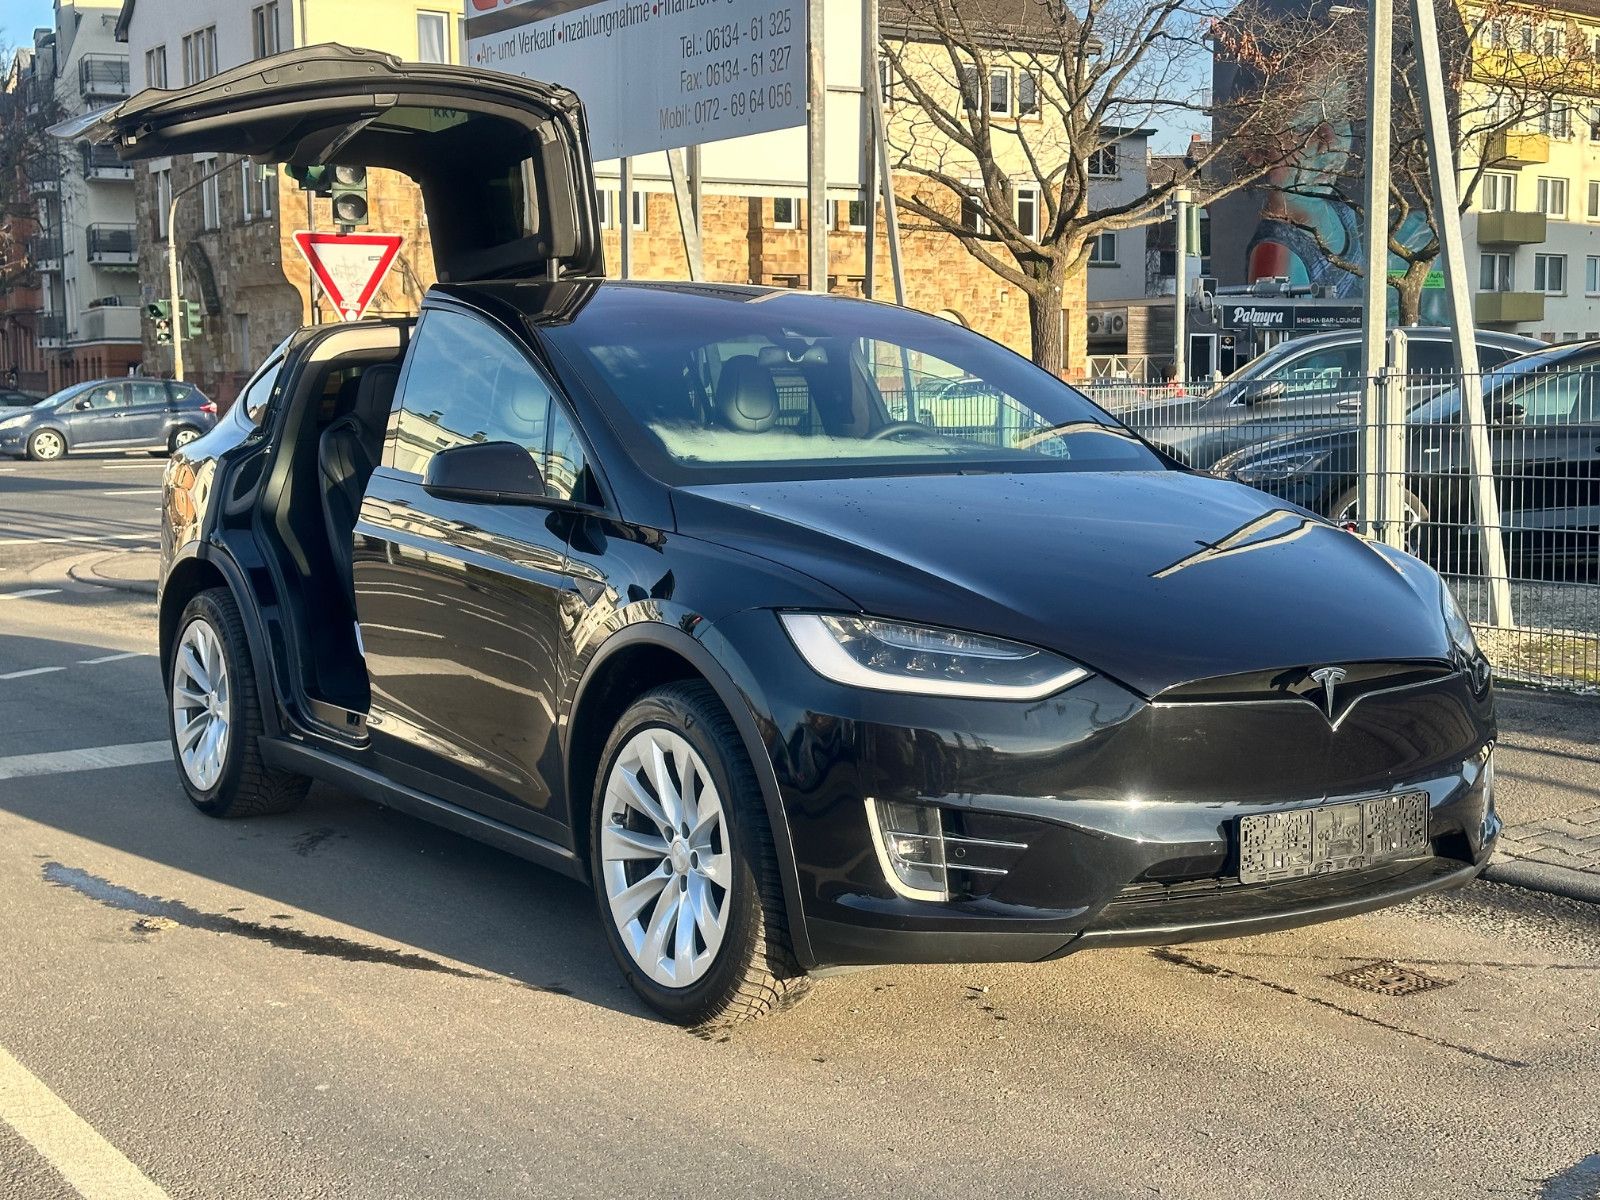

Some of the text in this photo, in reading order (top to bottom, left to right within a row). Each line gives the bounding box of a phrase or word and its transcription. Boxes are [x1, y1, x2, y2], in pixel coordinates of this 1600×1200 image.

[498, 35, 516, 61] und
[518, 22, 556, 54] Verkauf
[562, 1, 650, 44] Inzahlungnahme
[680, 33, 702, 59] Tel.:
[705, 22, 739, 53] 06134
[751, 15, 763, 42] 61
[769, 8, 791, 37] 325
[680, 69, 702, 93] Fax:
[706, 58, 740, 88] 06134
[751, 51, 763, 78] 61
[769, 45, 792, 73] 327
[659, 103, 691, 131] Mobil:
[694, 97, 720, 125] 0172
[730, 91, 746, 117] 69
[749, 87, 765, 113] 64
[768, 82, 792, 110] 056
[1232, 306, 1284, 326] Palmyra
